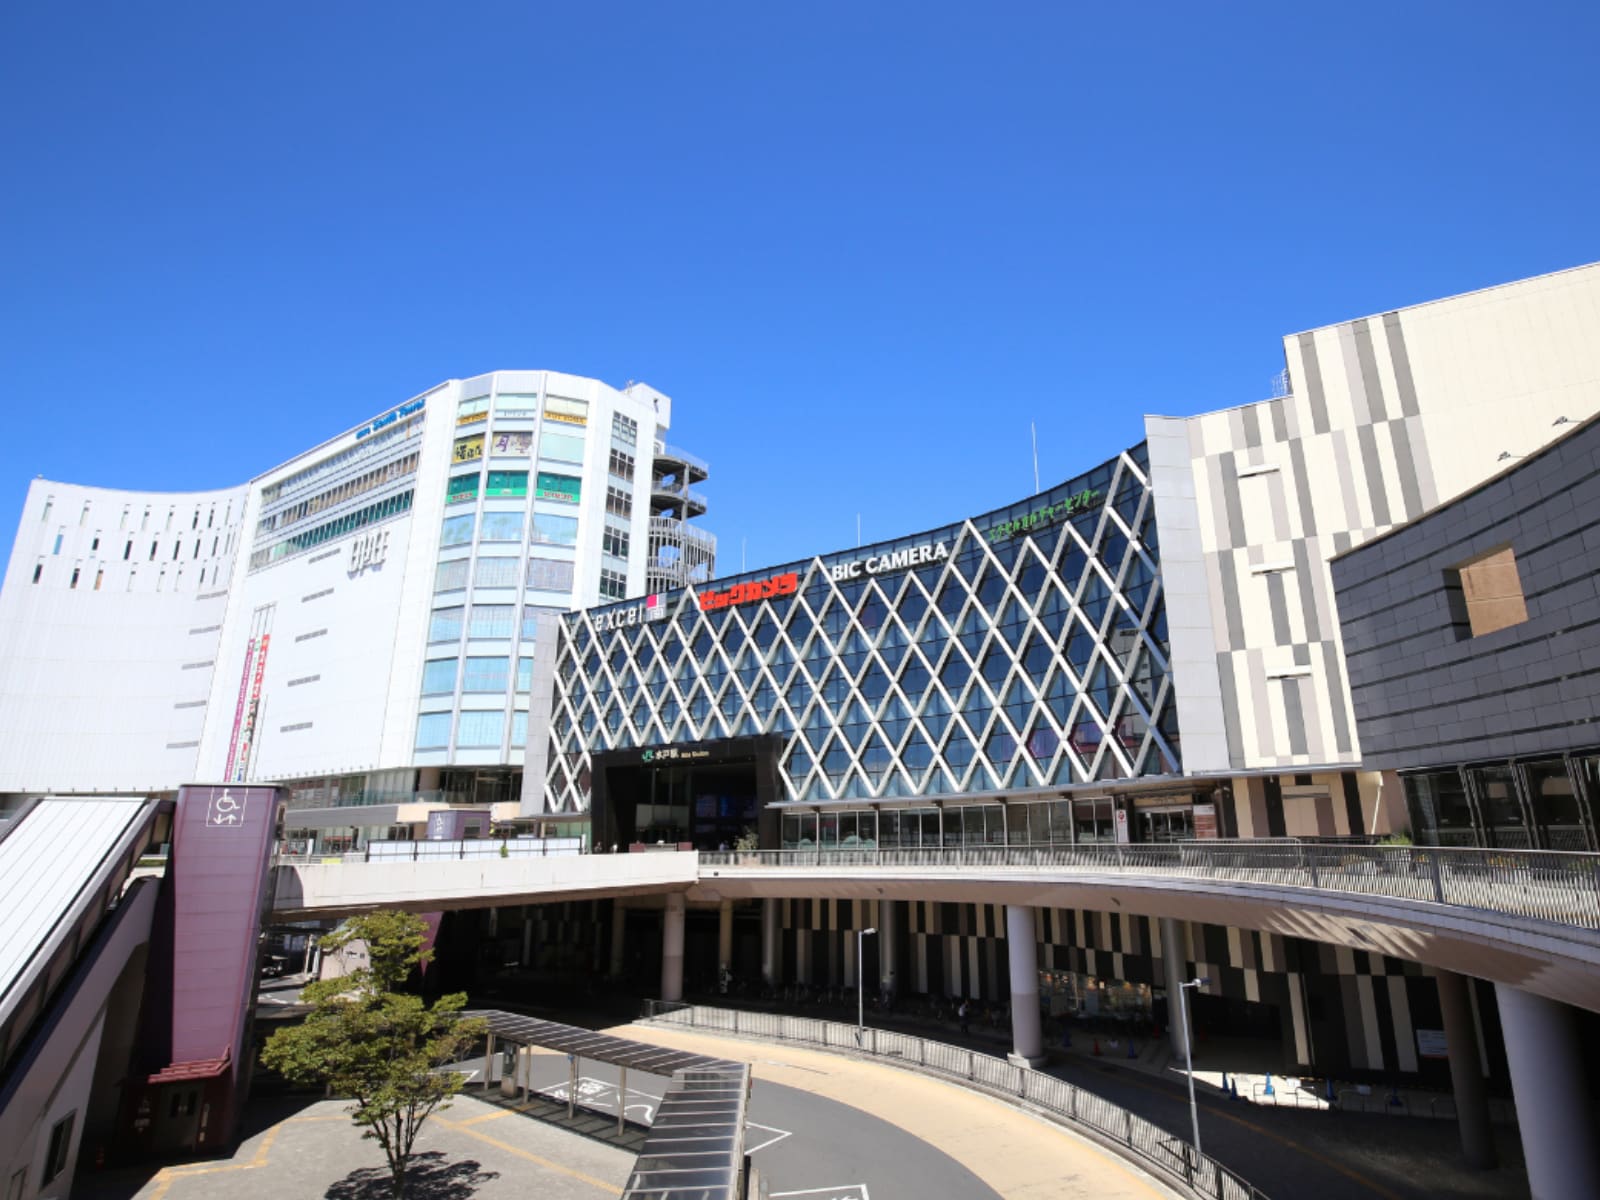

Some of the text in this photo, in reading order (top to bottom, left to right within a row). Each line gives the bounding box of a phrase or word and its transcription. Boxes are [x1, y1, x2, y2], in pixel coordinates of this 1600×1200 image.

[831, 542, 949, 581] BIC CAMERA
[700, 572, 798, 611] ビックカメラ
[594, 603, 643, 633] excel
